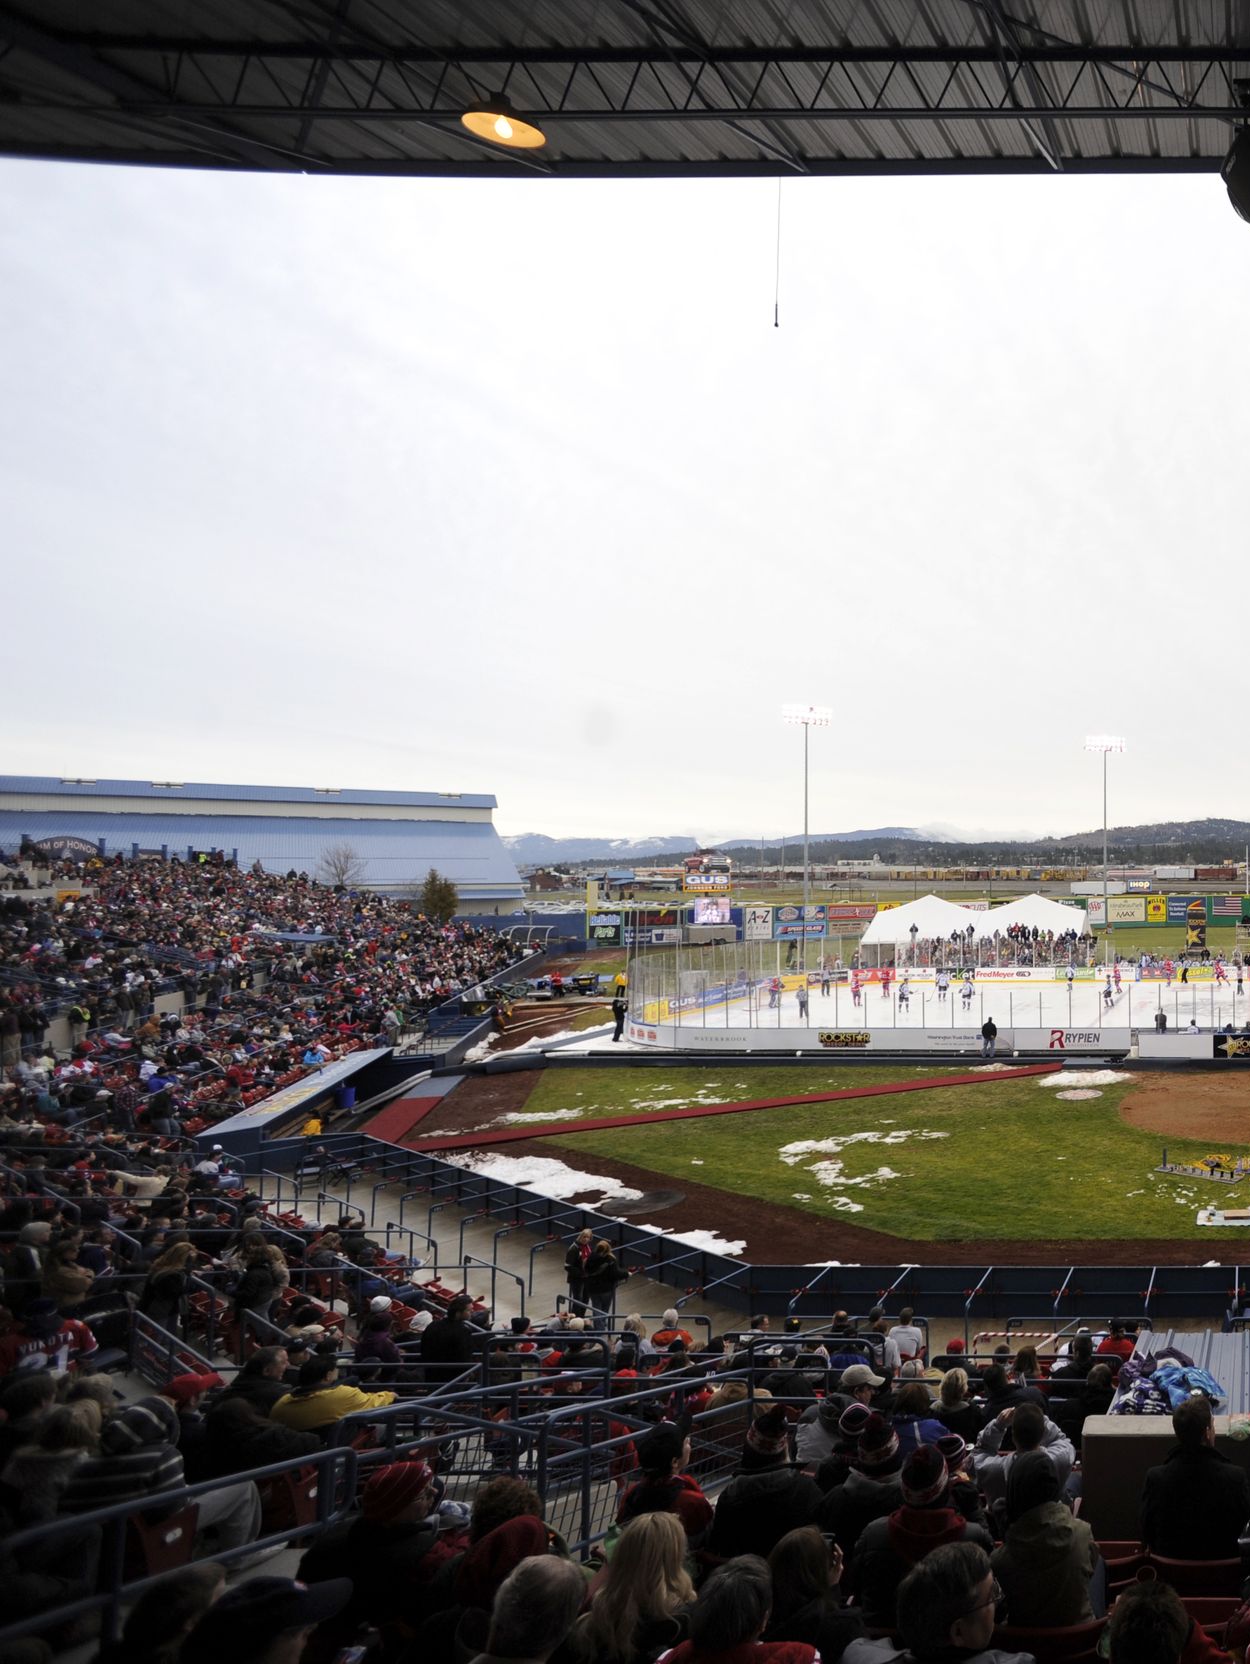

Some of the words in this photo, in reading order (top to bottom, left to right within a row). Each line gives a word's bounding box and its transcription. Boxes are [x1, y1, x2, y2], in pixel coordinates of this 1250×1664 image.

[67, 840, 98, 855] HONOR
[686, 876, 728, 884] GUS
[818, 1032, 871, 1043] ROCKSTAR
[1065, 1032, 1101, 1043] RYPIEN
